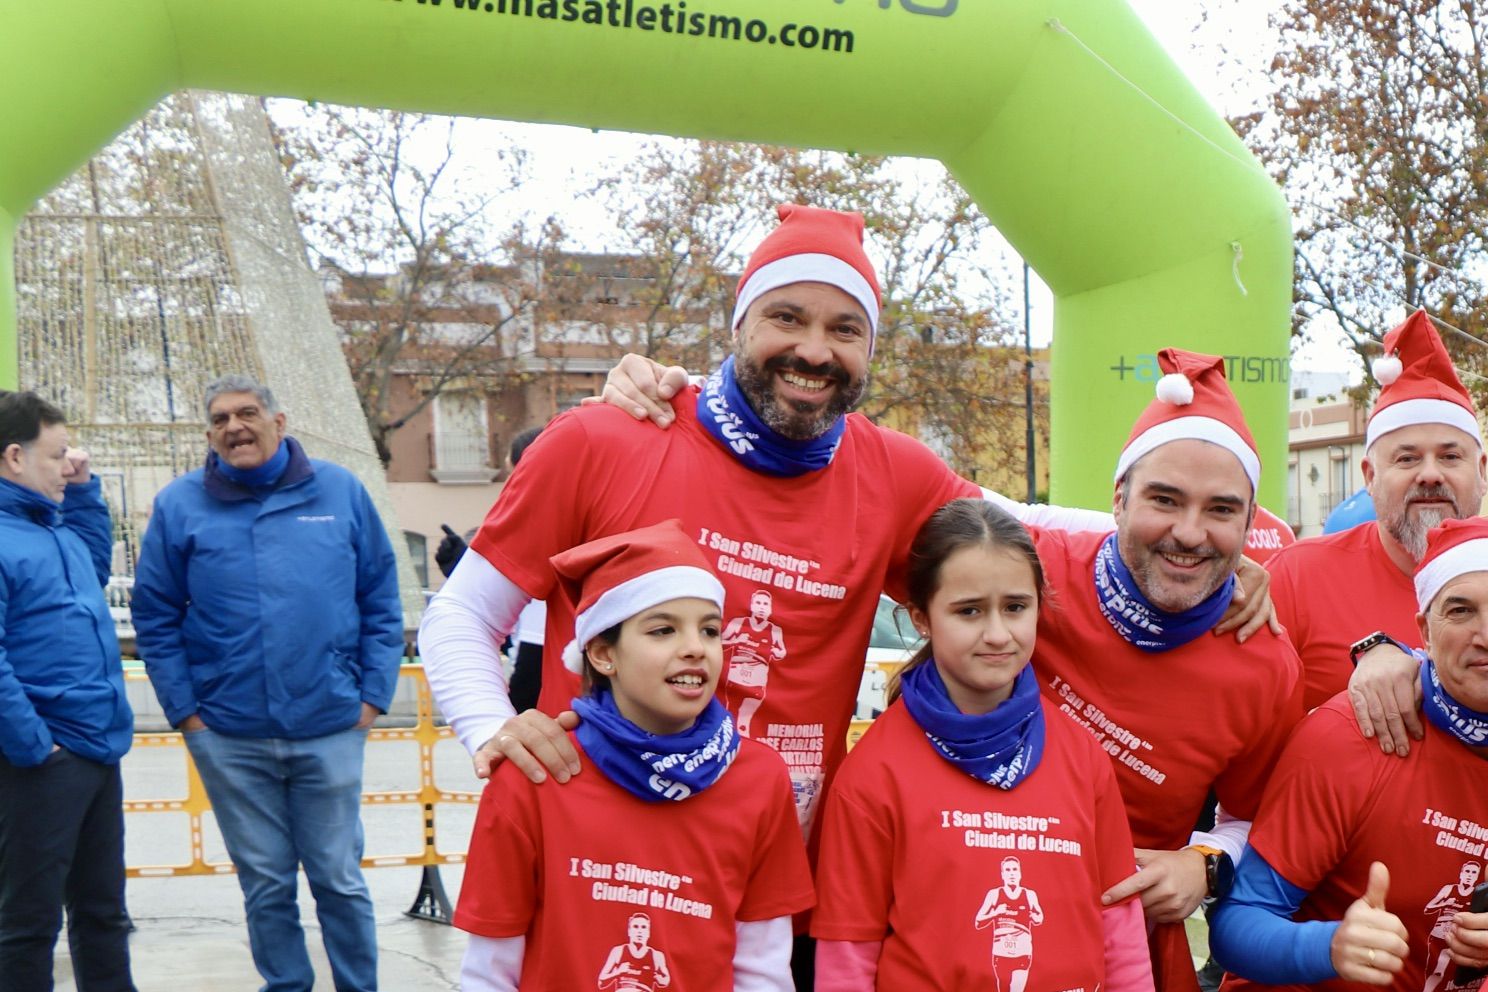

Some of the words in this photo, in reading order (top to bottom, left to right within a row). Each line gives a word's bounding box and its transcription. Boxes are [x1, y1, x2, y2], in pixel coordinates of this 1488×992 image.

[698, 528, 709, 545] I
[709, 532, 741, 556] San
[741, 541, 809, 574] Silvestre
[718, 555, 774, 585] Ciudad
[774, 572, 794, 590] de
[796, 575, 847, 600] Lucena
[1049, 676, 1061, 690] I
[1058, 682, 1085, 710] San
[1083, 704, 1141, 750] Silvestre
[767, 724, 824, 737] MEMORIAL
[781, 738, 823, 751] CARLOS
[1103, 741, 1121, 756] de
[1119, 749, 1166, 785] Lucena
[942, 811, 950, 828] I
[953, 811, 982, 827] San
[984, 811, 1048, 832] Silvestre
[1422, 808, 1433, 824] I
[1431, 811, 1458, 831] San
[965, 830, 1016, 849] Ciudad
[1018, 834, 1036, 851] de
[1435, 831, 1485, 857] Ciudad
[570, 858, 579, 876] I
[582, 859, 612, 879] San
[615, 862, 680, 890] Silvestre
[592, 882, 649, 906] Ciudad
[650, 890, 665, 909] de
[666, 893, 712, 919] Lucena
